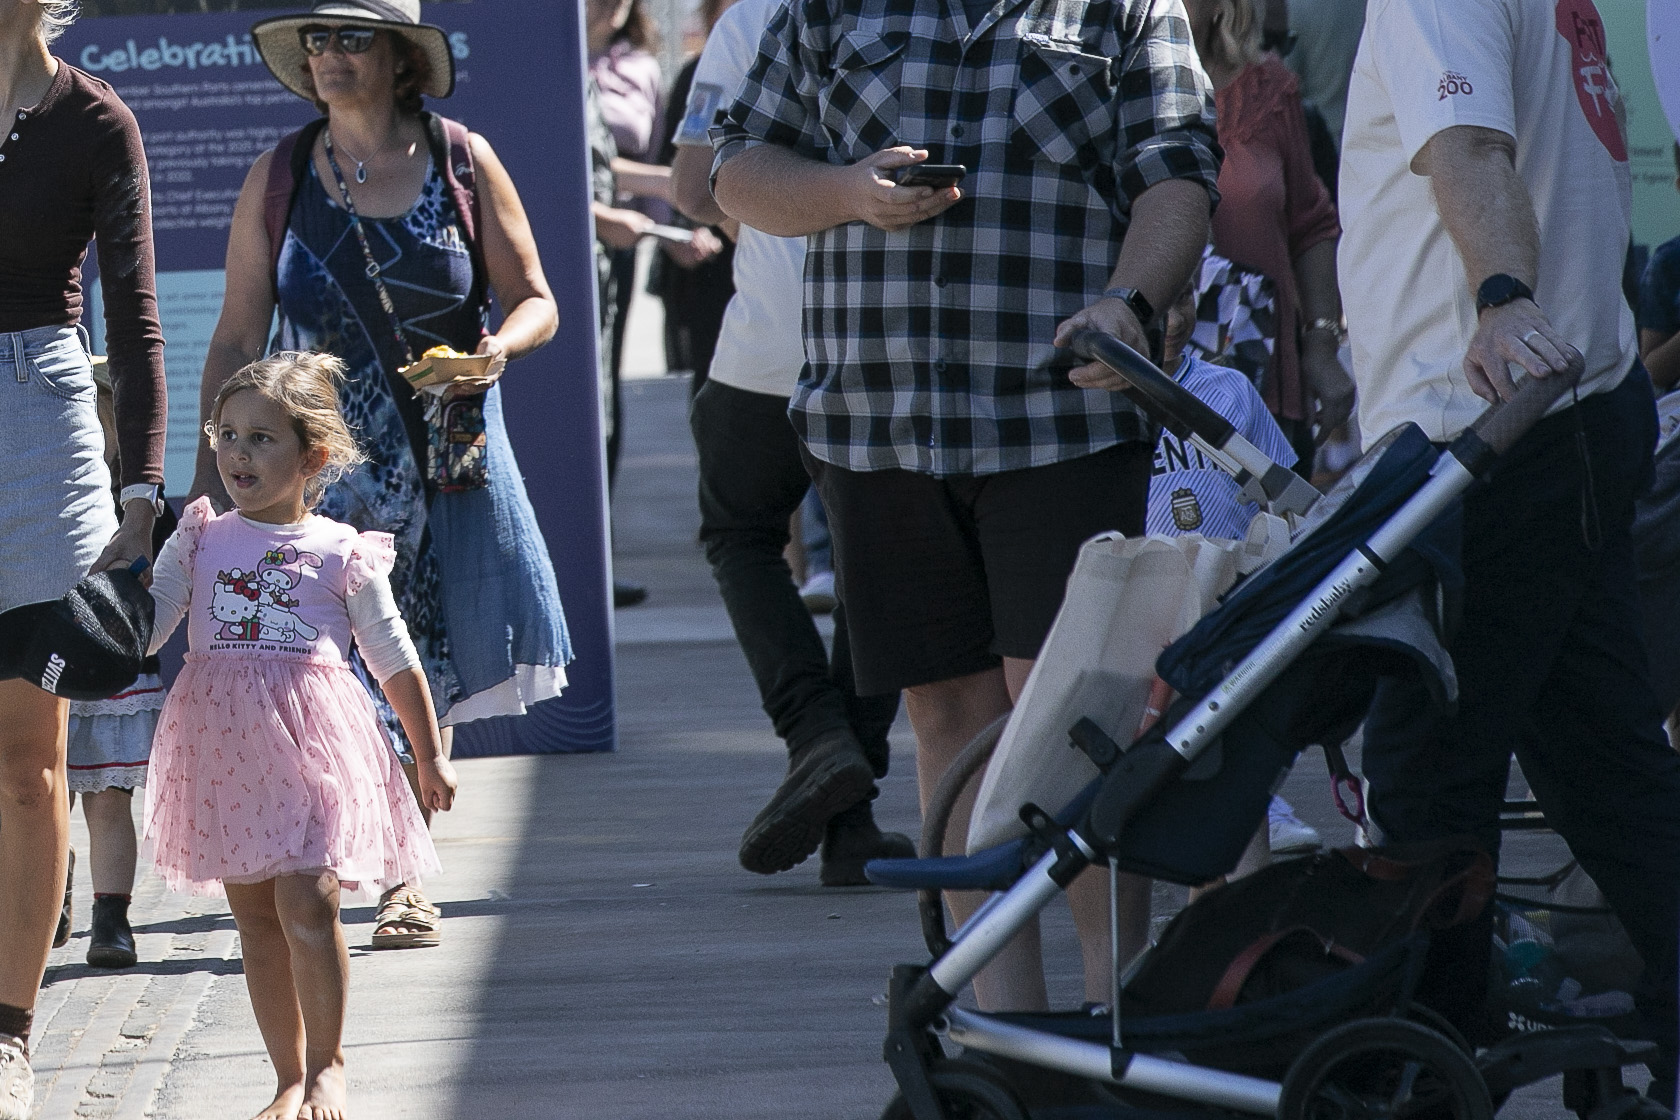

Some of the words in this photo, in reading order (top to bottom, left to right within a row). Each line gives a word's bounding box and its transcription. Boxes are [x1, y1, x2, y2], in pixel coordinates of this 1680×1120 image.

[80, 33, 263, 72] Celebrati
[1437, 80, 1474, 101] 200
[1299, 578, 1353, 632] redsbaby
[209, 643, 231, 651] HELLO
[279, 646, 312, 655] FRIENDS
